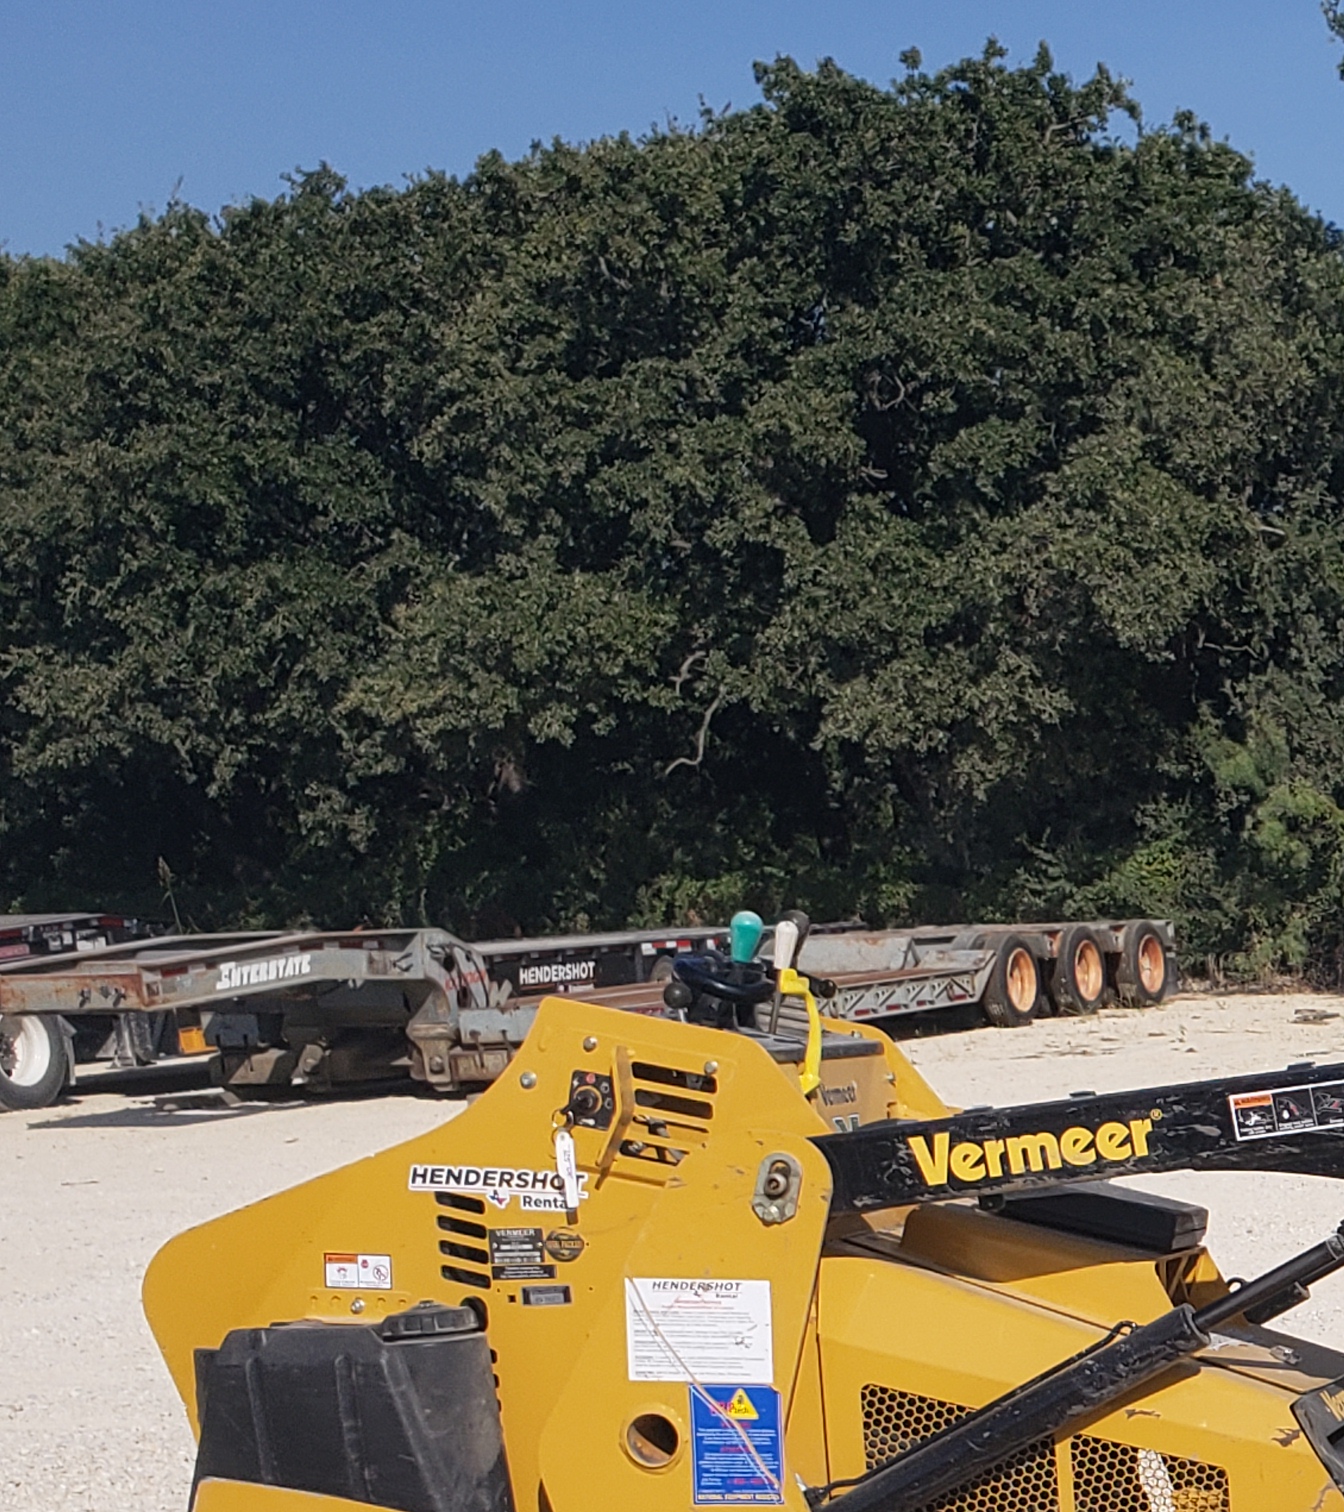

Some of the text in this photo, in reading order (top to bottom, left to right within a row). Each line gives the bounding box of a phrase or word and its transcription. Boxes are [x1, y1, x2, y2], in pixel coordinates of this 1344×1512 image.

[216, 954, 311, 990] INTERSTATE
[519, 961, 596, 985] HENDERSHOT
[907, 1117, 1153, 1187] Vermeer
[523, 1195, 570, 1210] Renta
[652, 1281, 742, 1292] HENDERSHOT
